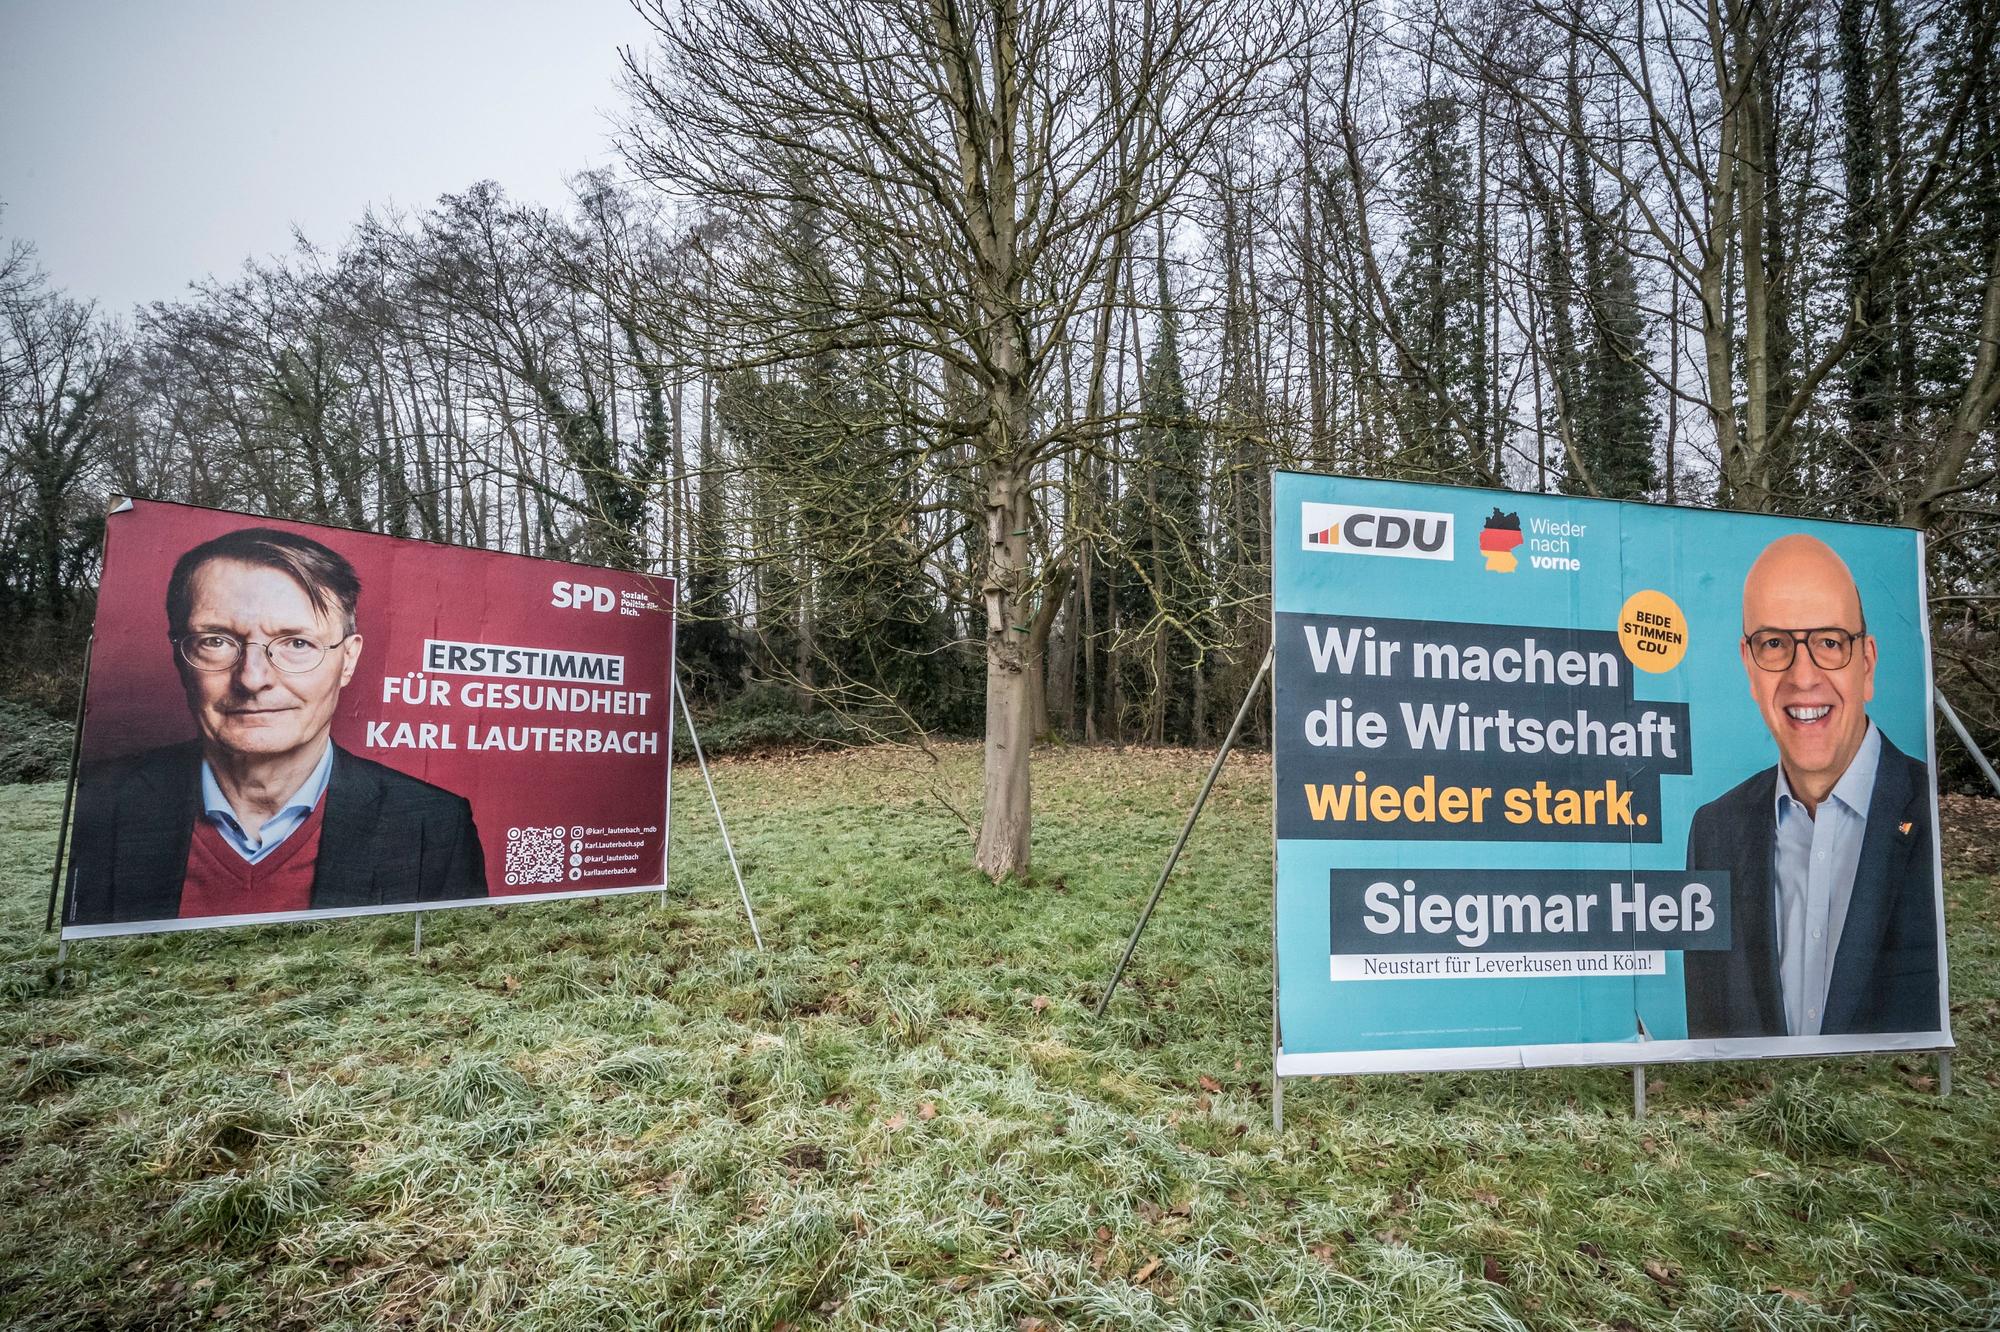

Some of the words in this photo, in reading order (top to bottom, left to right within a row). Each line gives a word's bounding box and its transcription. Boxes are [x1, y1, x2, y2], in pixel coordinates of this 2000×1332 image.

[1343, 514, 1448, 552] CDU
[1530, 518, 1587, 537] Wieder
[1530, 536, 1569, 553] nach
[1530, 555, 1580, 571] vorne
[551, 581, 615, 612] SPD
[621, 591, 648, 600] Soziale
[621, 607, 640, 617] Dich.
[1636, 611, 1671, 628] BEIDE
[1624, 622, 1682, 645] STIMMEN
[1304, 626, 1400, 676] Wir
[1413, 638, 1619, 687] machen
[1637, 640, 1667, 655] CDU
[428, 644, 620, 681] ERSTSTIMME
[383, 671, 451, 706] FÜR
[460, 682, 651, 715] GESUNDHEIT
[366, 721, 456, 750] KARL
[467, 725, 657, 754] LAUTERBACH
[1304, 697, 1387, 748] die
[1400, 702, 1677, 758] Wirtschaft
[1304, 771, 1492, 823] wieder
[1504, 780, 1648, 826] stark.
[585, 826, 657, 836] @karl_lauterbach_mdb
[584, 853, 639, 863] @karl_lauterbach
[583, 867, 637, 876] karllauterbach.de
[1363, 879, 1597, 948] Siegmar
[1610, 882, 1715, 932] Heß
[1364, 958, 1440, 974] Neustart
[1446, 956, 1471, 973] für
[1475, 955, 1572, 973] Leverkusen
[1577, 954, 1608, 971] und
[1613, 954, 1652, 970] Kön!
